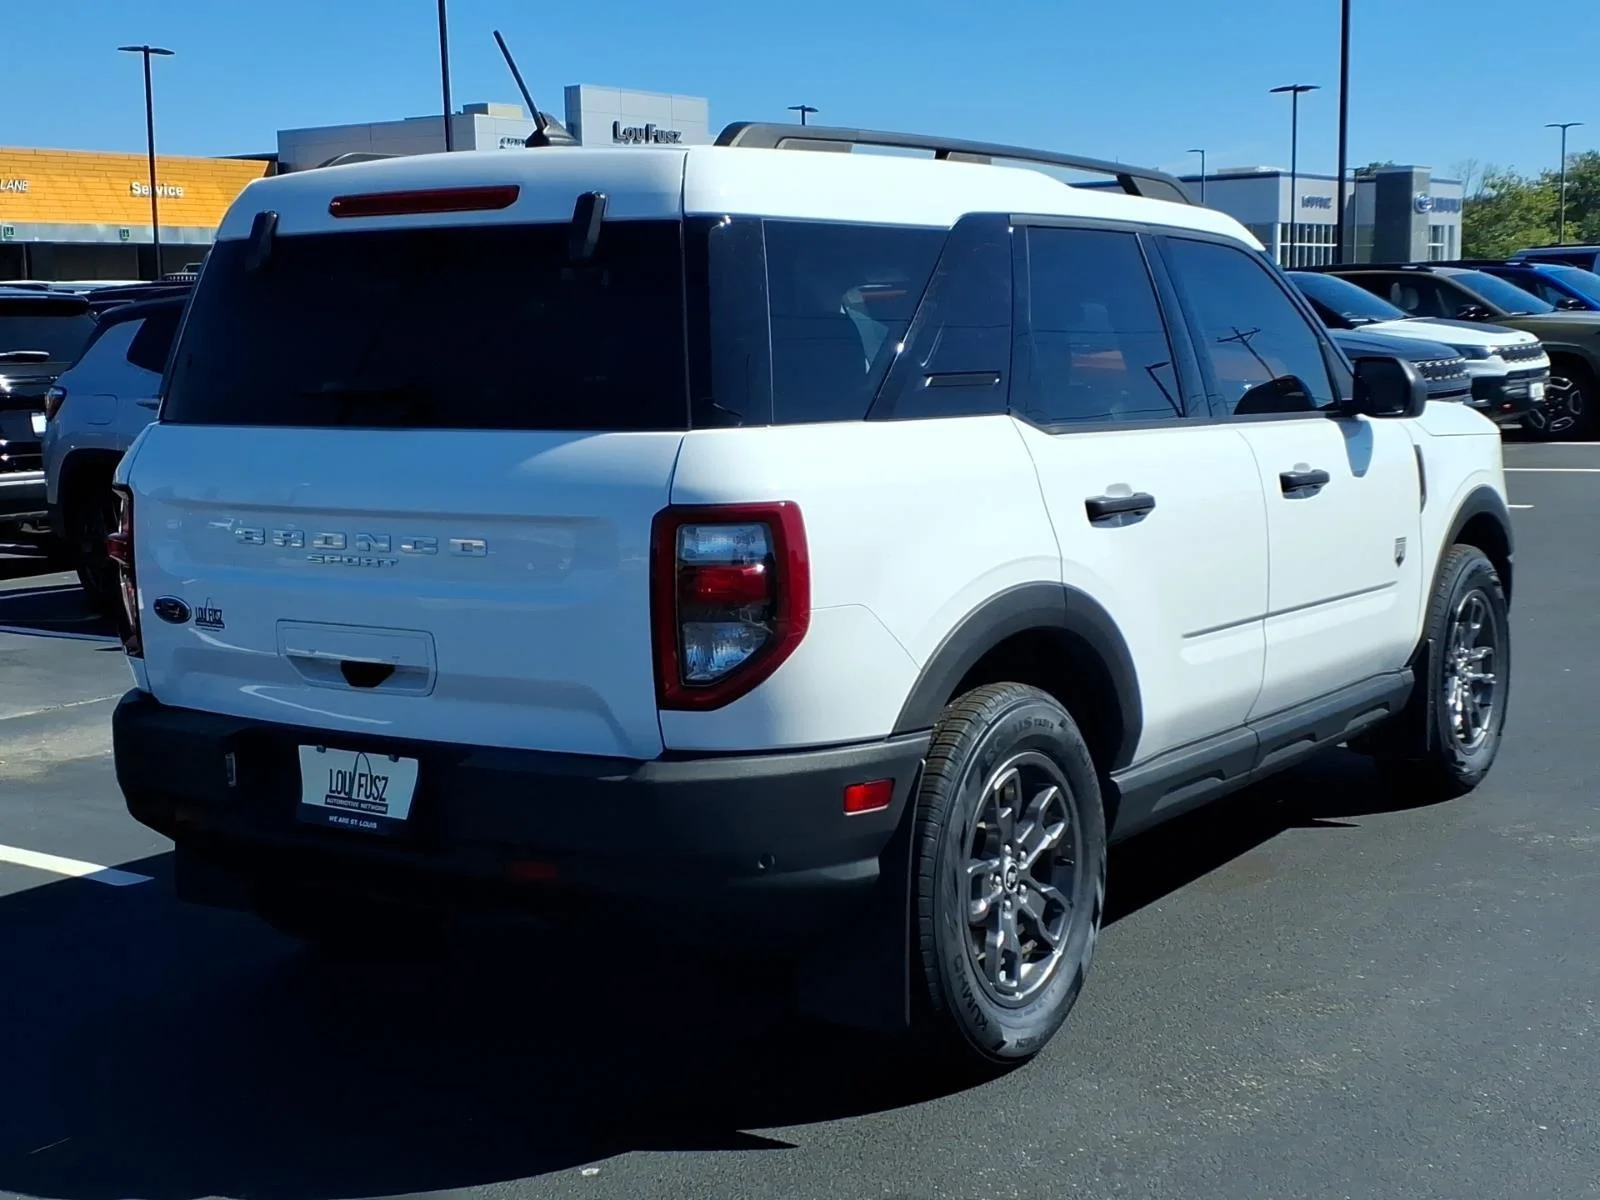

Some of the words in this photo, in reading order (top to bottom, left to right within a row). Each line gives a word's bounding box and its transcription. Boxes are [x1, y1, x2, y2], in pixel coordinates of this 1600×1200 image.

[0, 179, 29, 191] LANE
[234, 527, 488, 557] BRONCO
[306, 553, 400, 568] SPORT
[329, 768, 353, 797] LOU
[357, 772, 389, 802] FUSZ
